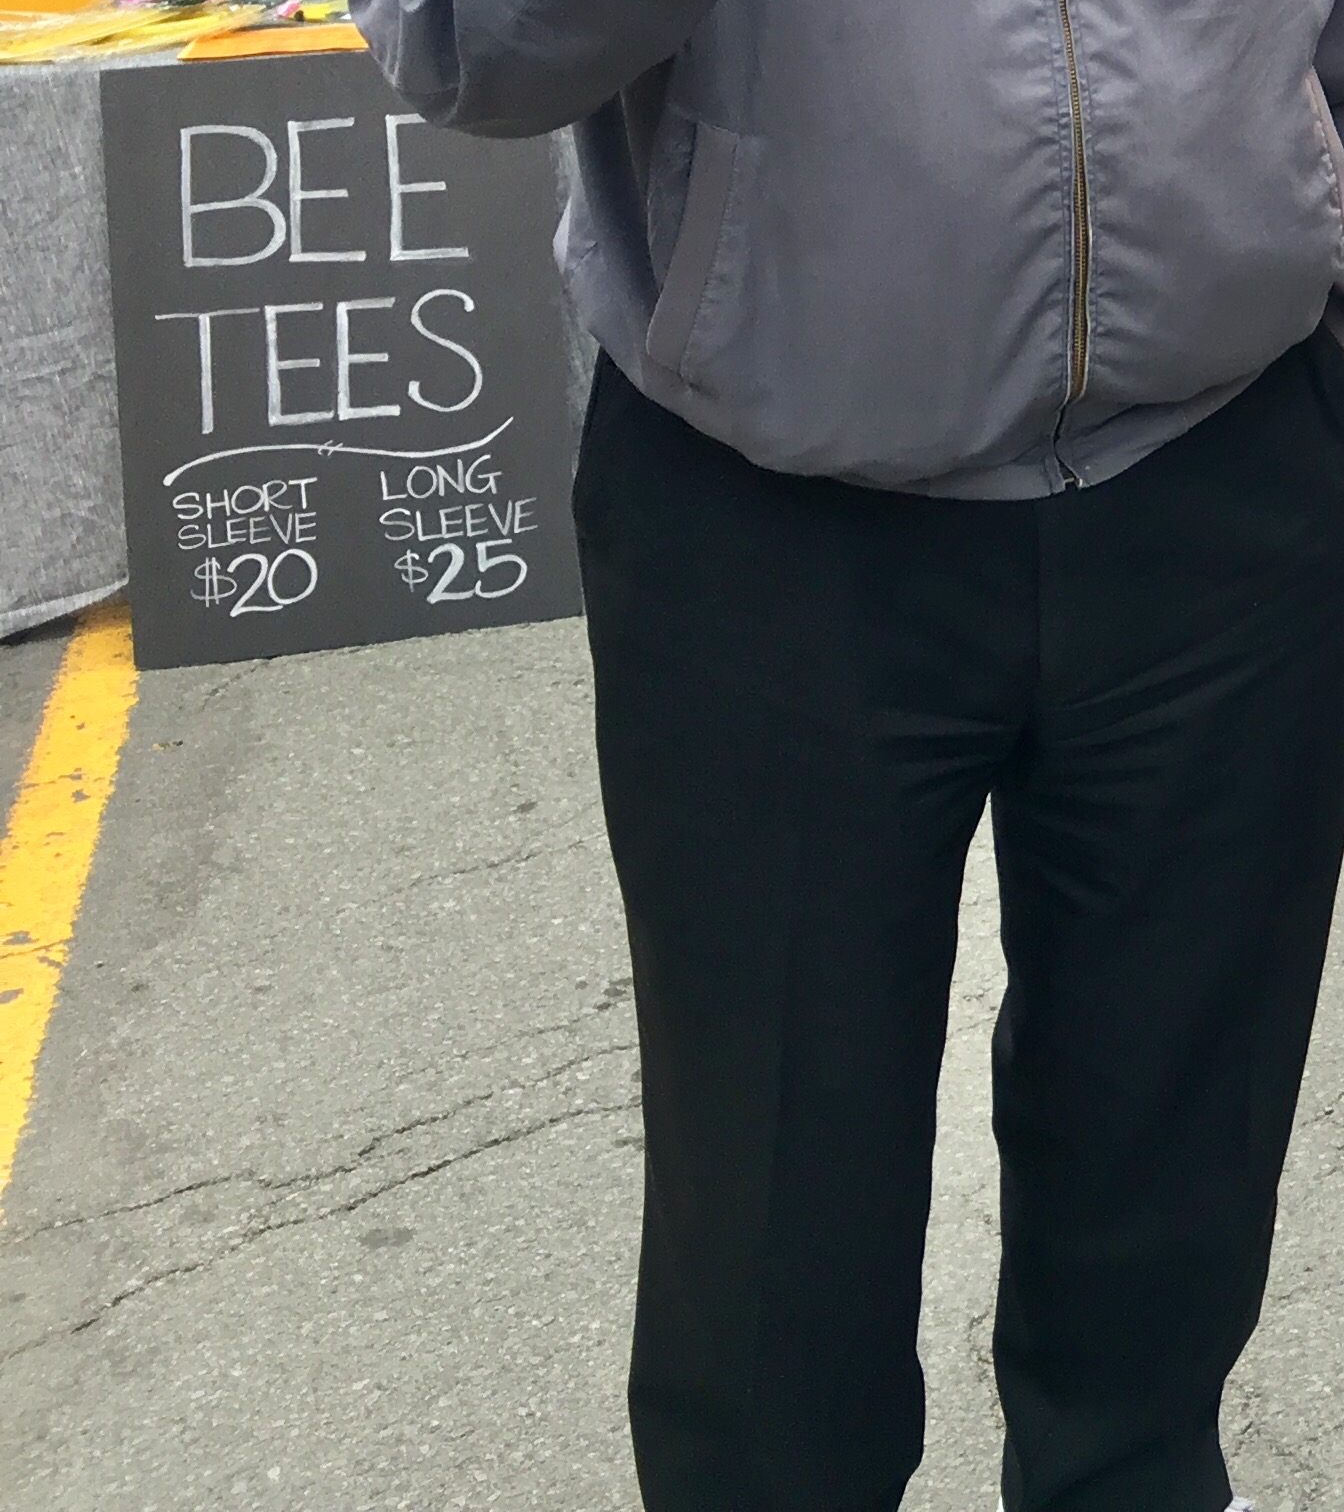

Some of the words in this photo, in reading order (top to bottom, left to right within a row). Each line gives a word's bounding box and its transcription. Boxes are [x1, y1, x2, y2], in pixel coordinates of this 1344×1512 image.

[180, 113, 470, 268] BEE
[154, 288, 483, 434] TEES
[172, 476, 318, 520] SHORT
[380, 454, 502, 501] LONG
[177, 511, 317, 550] SLEEVE
[378, 497, 538, 541] SLEEVE
[190, 548, 318, 617] $20
[394, 538, 528, 604] $25
